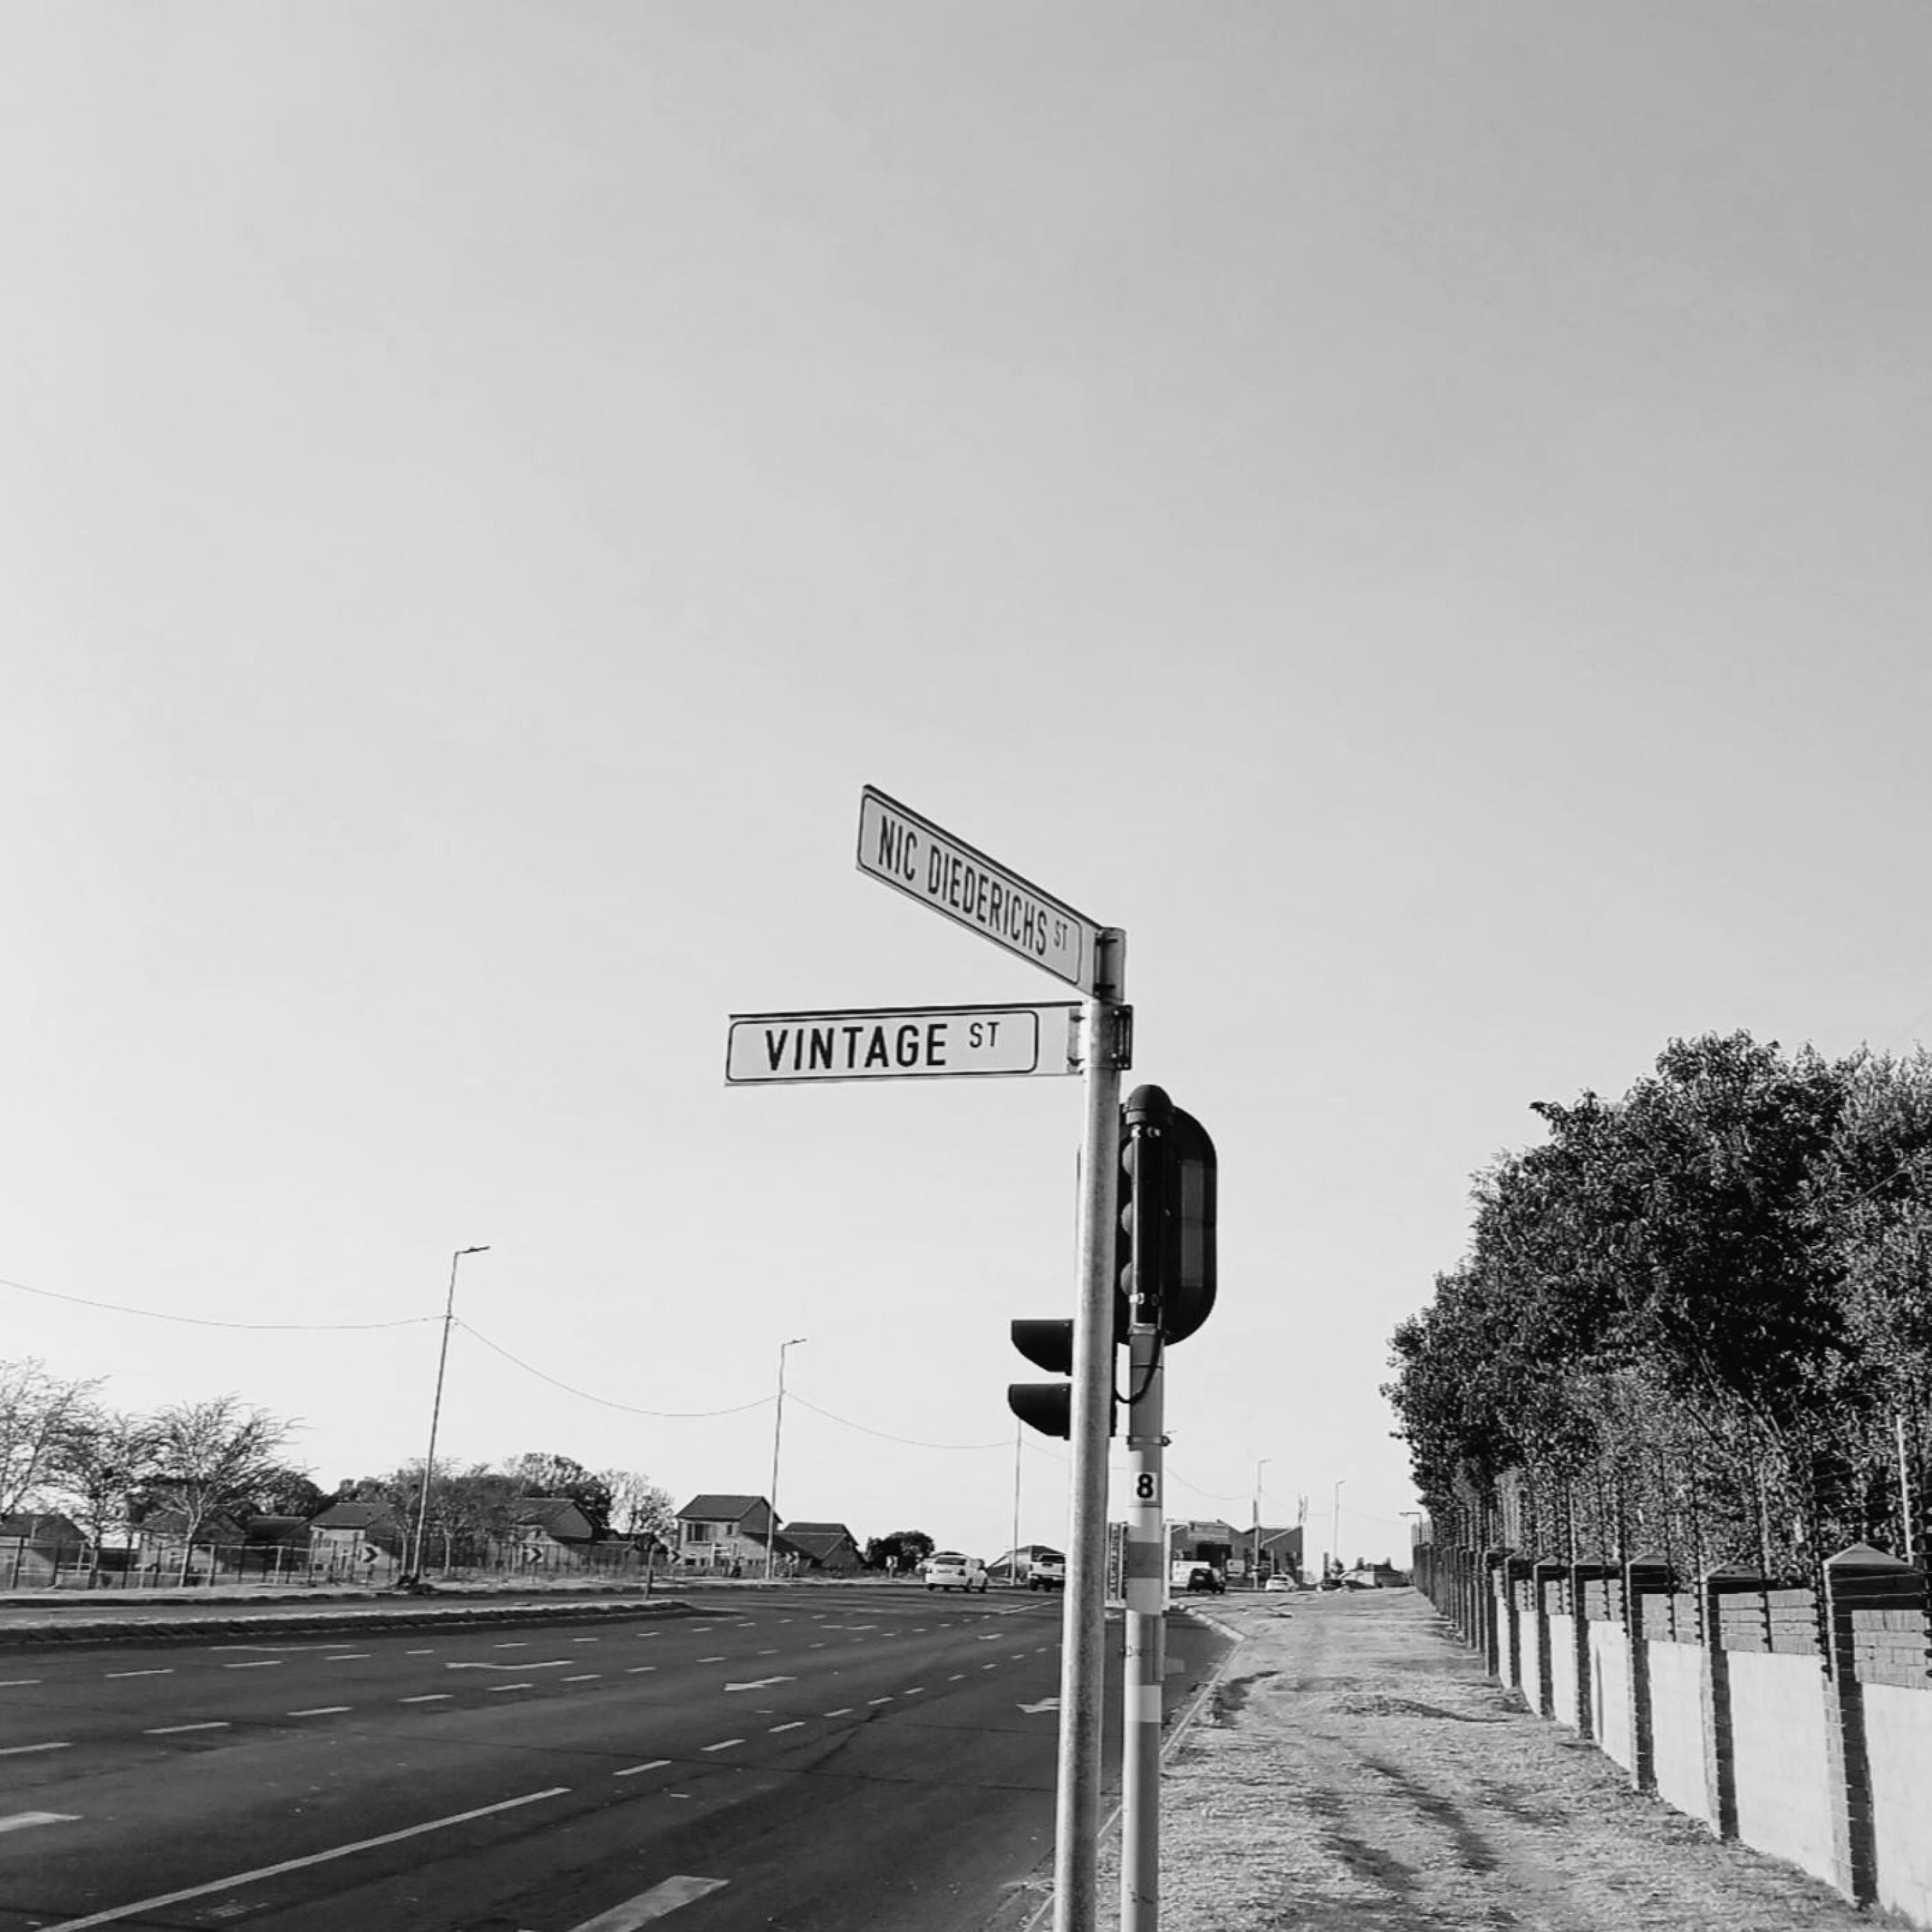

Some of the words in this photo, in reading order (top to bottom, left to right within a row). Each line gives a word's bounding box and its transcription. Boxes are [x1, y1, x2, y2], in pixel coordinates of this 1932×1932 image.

[879, 815, 917, 880] NIC
[928, 845, 1047, 955] DIEDERICHS
[1054, 920, 1068, 950] ST
[765, 1023, 948, 1070] VINTAGE
[969, 1021, 1001, 1048] ST
[1137, 1473, 1153, 1498] 8
